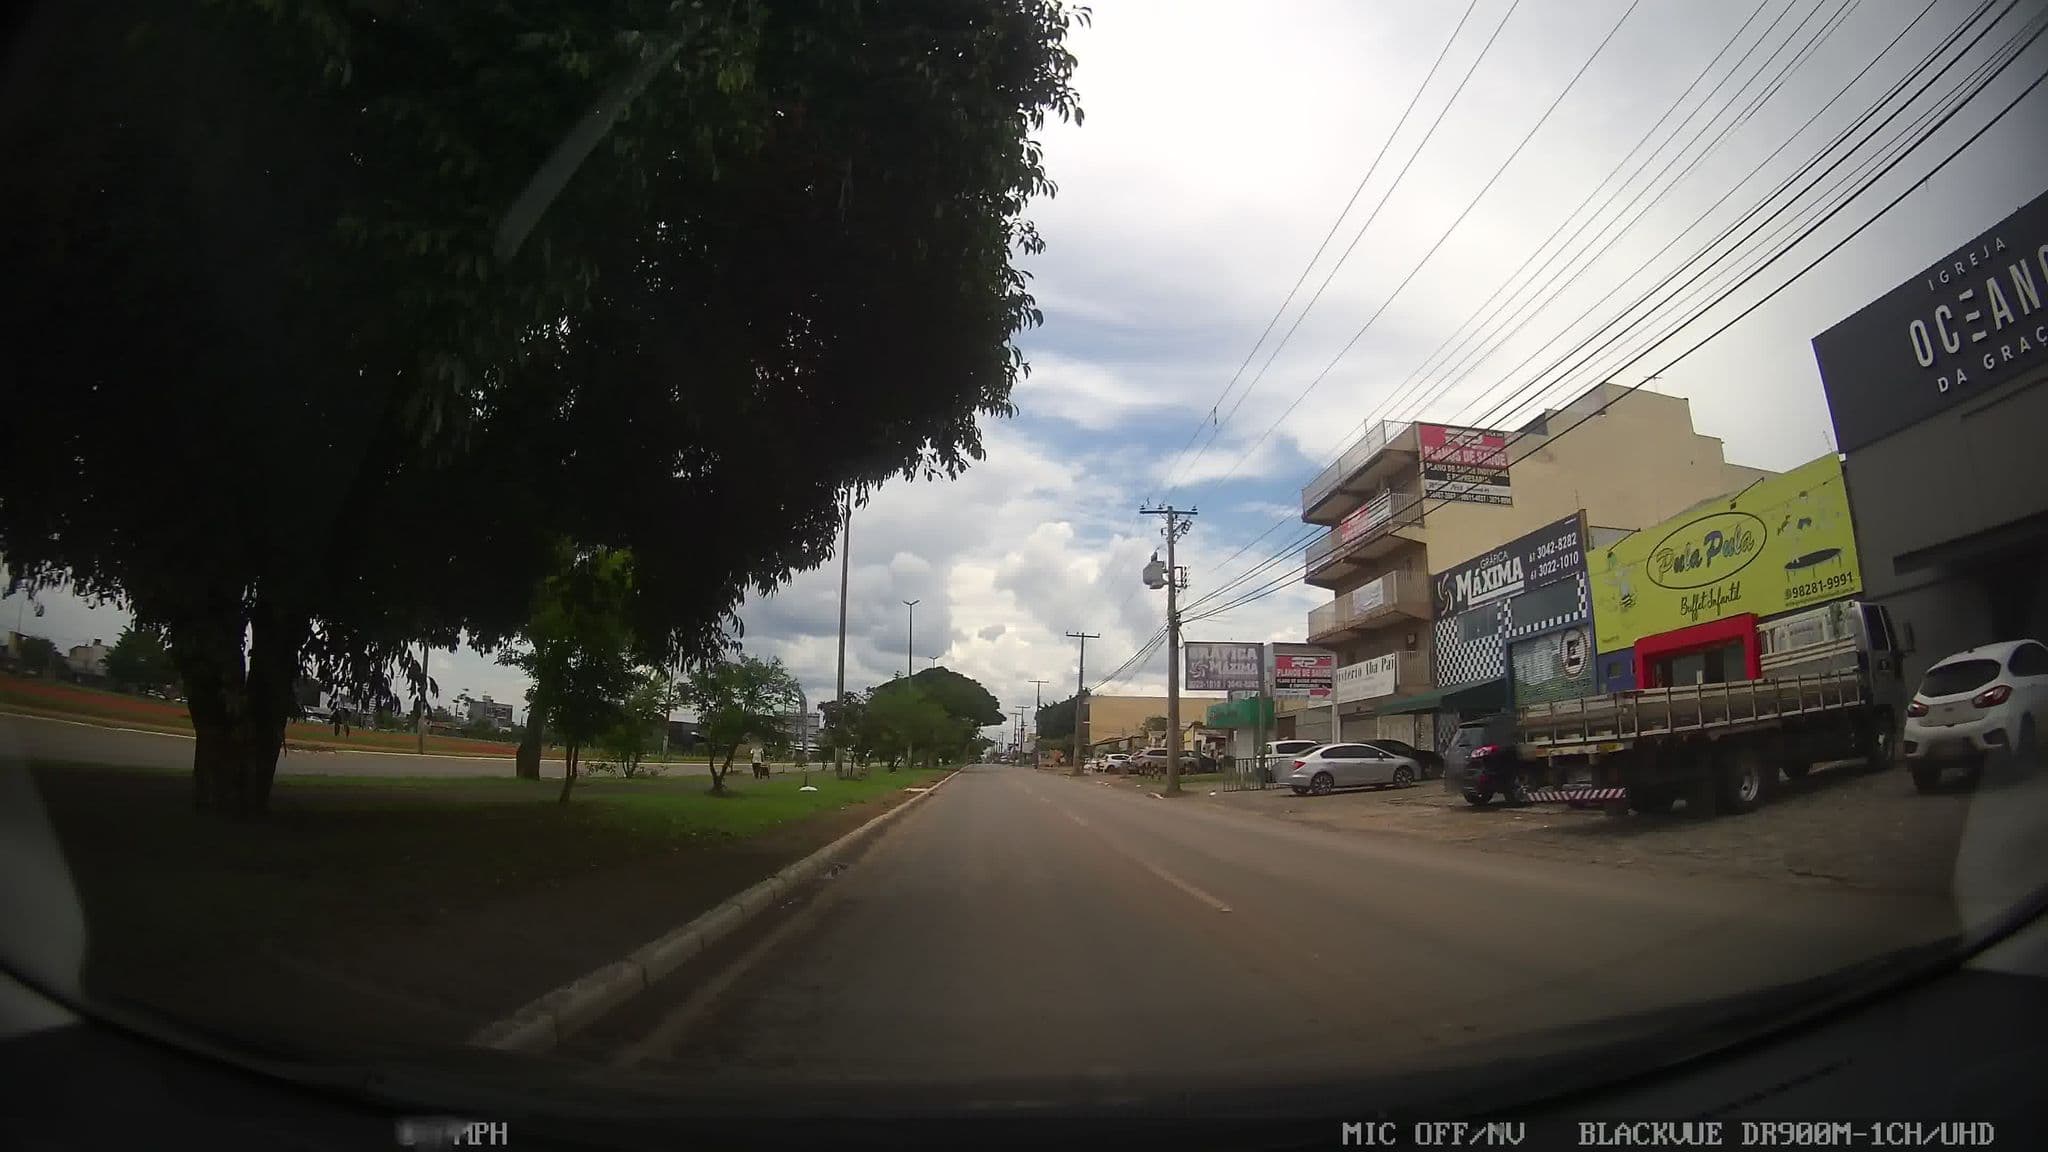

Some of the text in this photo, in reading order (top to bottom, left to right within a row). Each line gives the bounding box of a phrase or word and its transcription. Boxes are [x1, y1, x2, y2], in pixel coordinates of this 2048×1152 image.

[1928, 236, 2006, 291] IGREJA
[1937, 368, 1968, 392] DA
[1537, 532, 1577, 559] 3042-8282
[1538, 551, 1579, 577] 3022-1010
[1456, 556, 1524, 605] MÁXIMA
[1792, 570, 1853, 598] 98281-9991
[1680, 591, 1707, 622] Buffet
